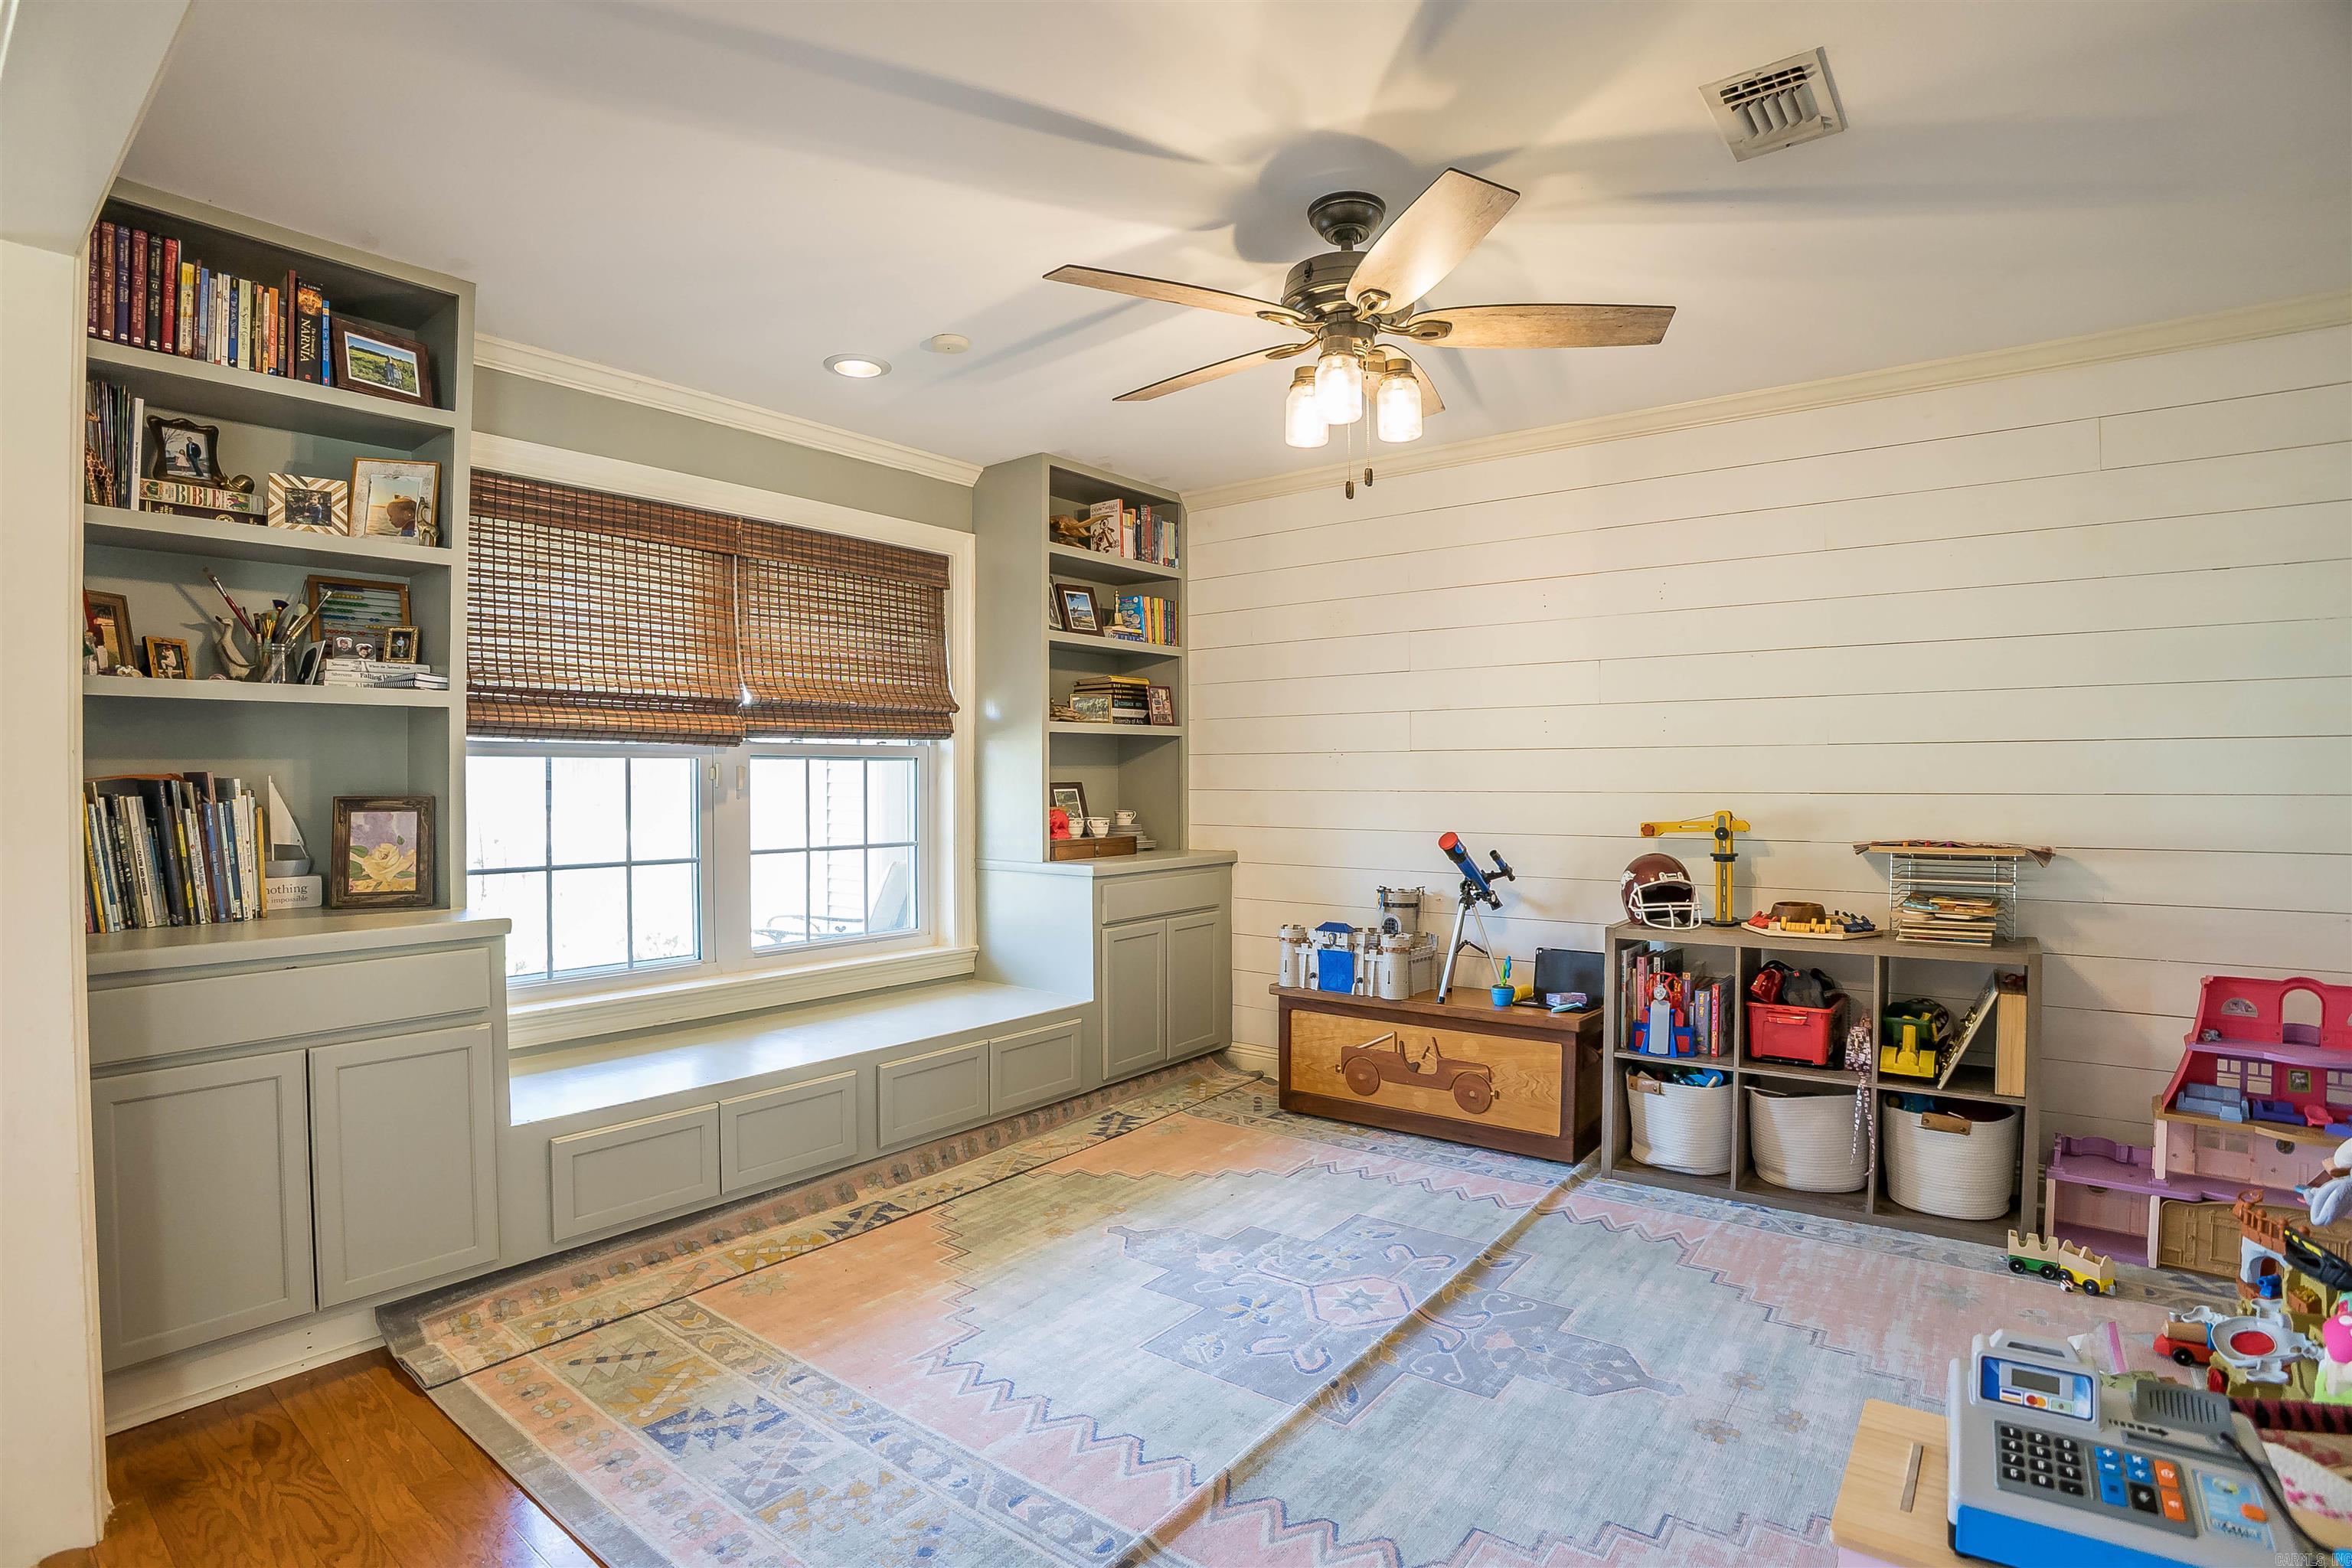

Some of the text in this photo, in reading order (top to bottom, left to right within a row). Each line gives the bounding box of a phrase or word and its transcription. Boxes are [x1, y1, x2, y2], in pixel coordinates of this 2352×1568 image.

[300, 318, 311, 361] NARNIA
[175, 484, 220, 508] BIBLE
[266, 884, 308, 894] nothing
